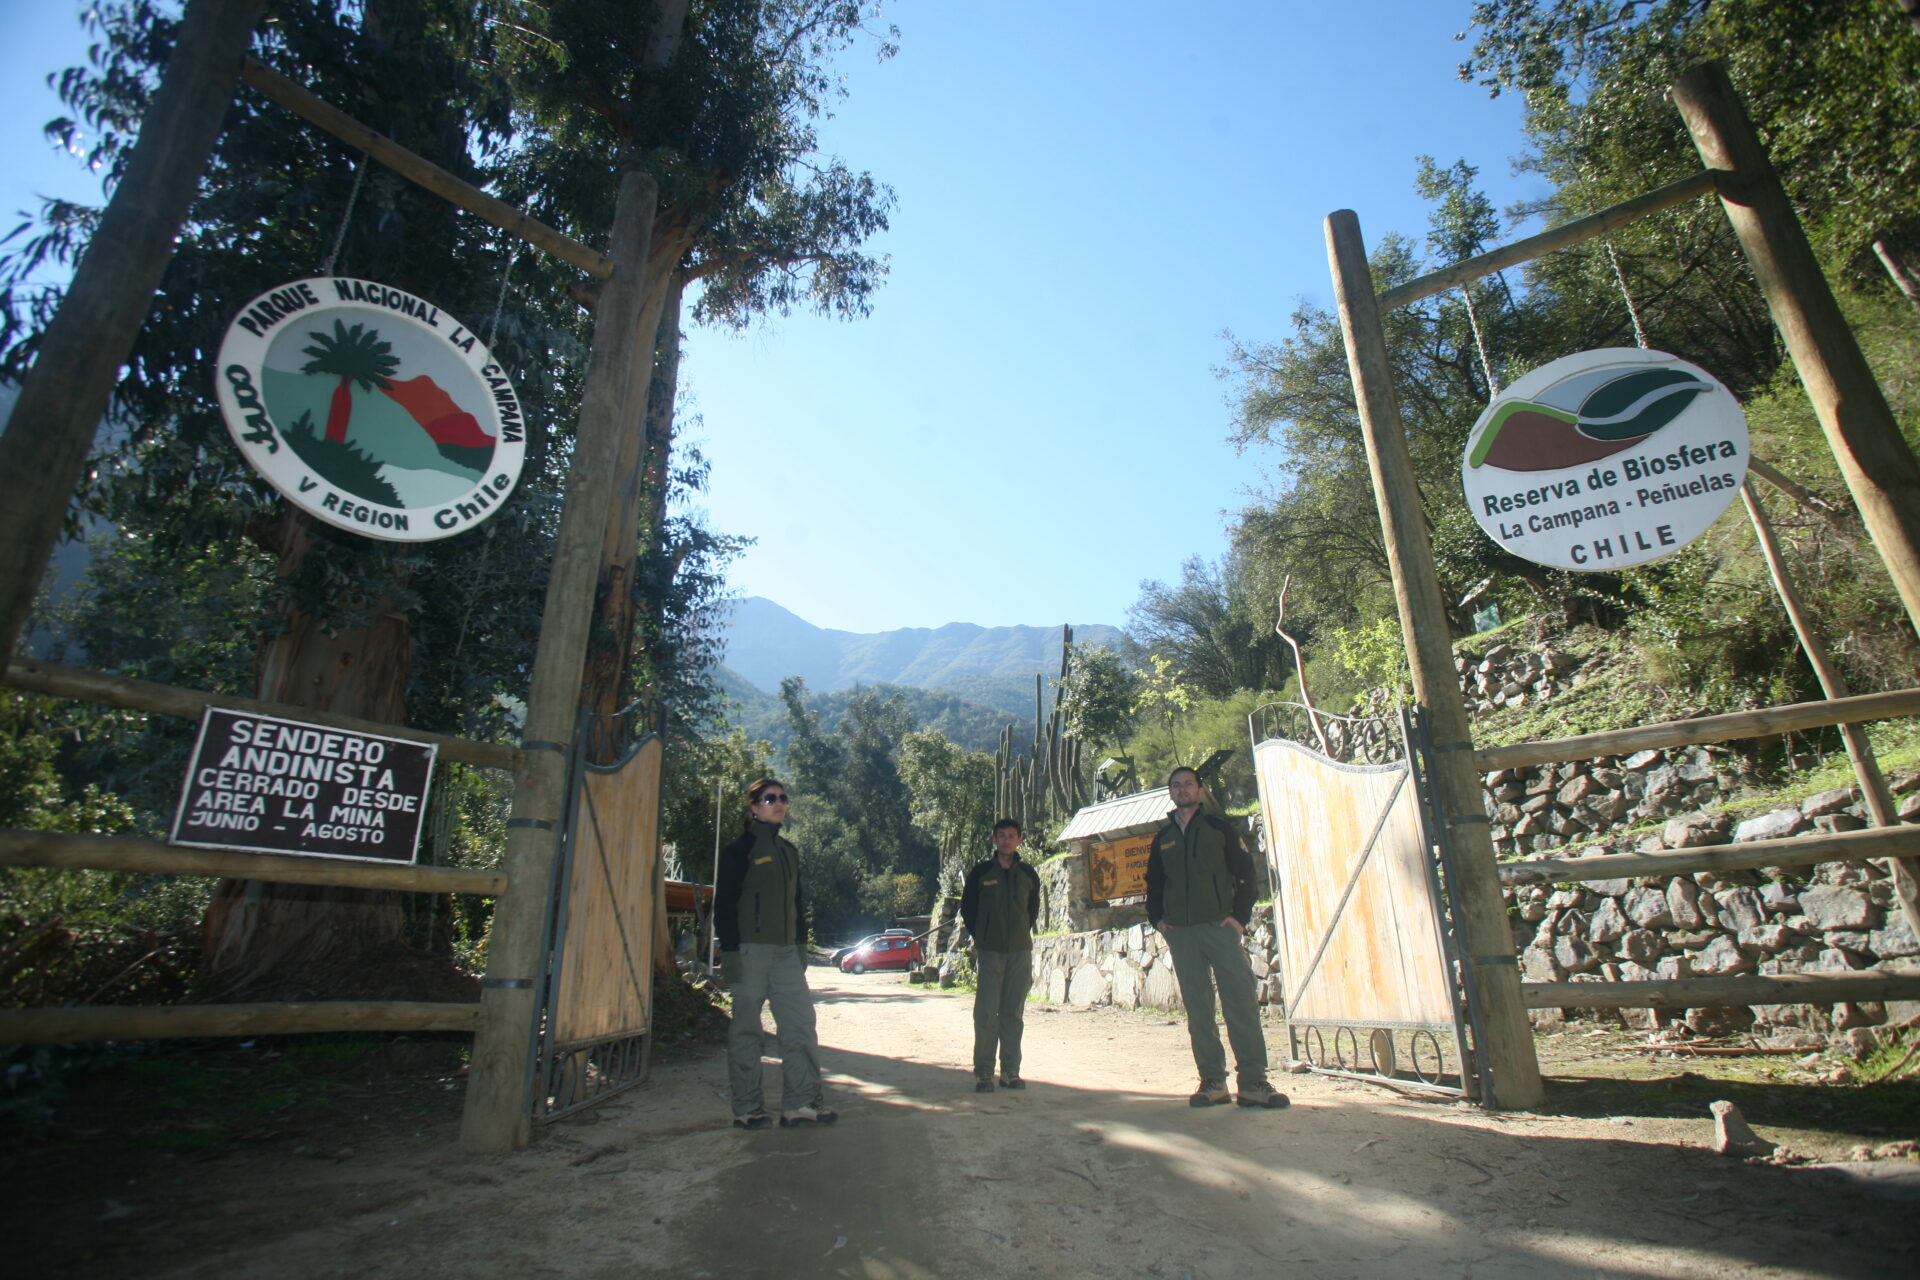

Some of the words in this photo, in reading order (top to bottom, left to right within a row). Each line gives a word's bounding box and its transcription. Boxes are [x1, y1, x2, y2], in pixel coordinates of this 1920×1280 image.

[238, 283, 320, 338] PARQUE
[333, 279, 439, 327] NACIONAL
[449, 326, 477, 353] LA
[481, 363, 524, 444] CAMPANA
[433, 472, 511, 530] Chile
[1482, 479, 1581, 517] Reserva
[1587, 468, 1618, 491] de
[1622, 439, 1737, 482] Biosfera
[297, 475, 318, 493] V
[322, 491, 411, 531] REGION
[1499, 521, 1523, 540] La
[1528, 499, 1621, 534] Campana
[1636, 472, 1736, 508] Peñuelas
[1570, 524, 1676, 565] CHILE
[229, 720, 385, 765] SENDERO
[198, 767, 319, 800] CERRADO
[342, 787, 418, 813] DESDE
[219, 745, 394, 791] ANDINISTA
[187, 811, 260, 832] JUNIO
[301, 822, 385, 844] AGOSTO
[195, 790, 266, 815] AREA
[282, 800, 316, 820] LA
[329, 805, 385, 828] MINA
